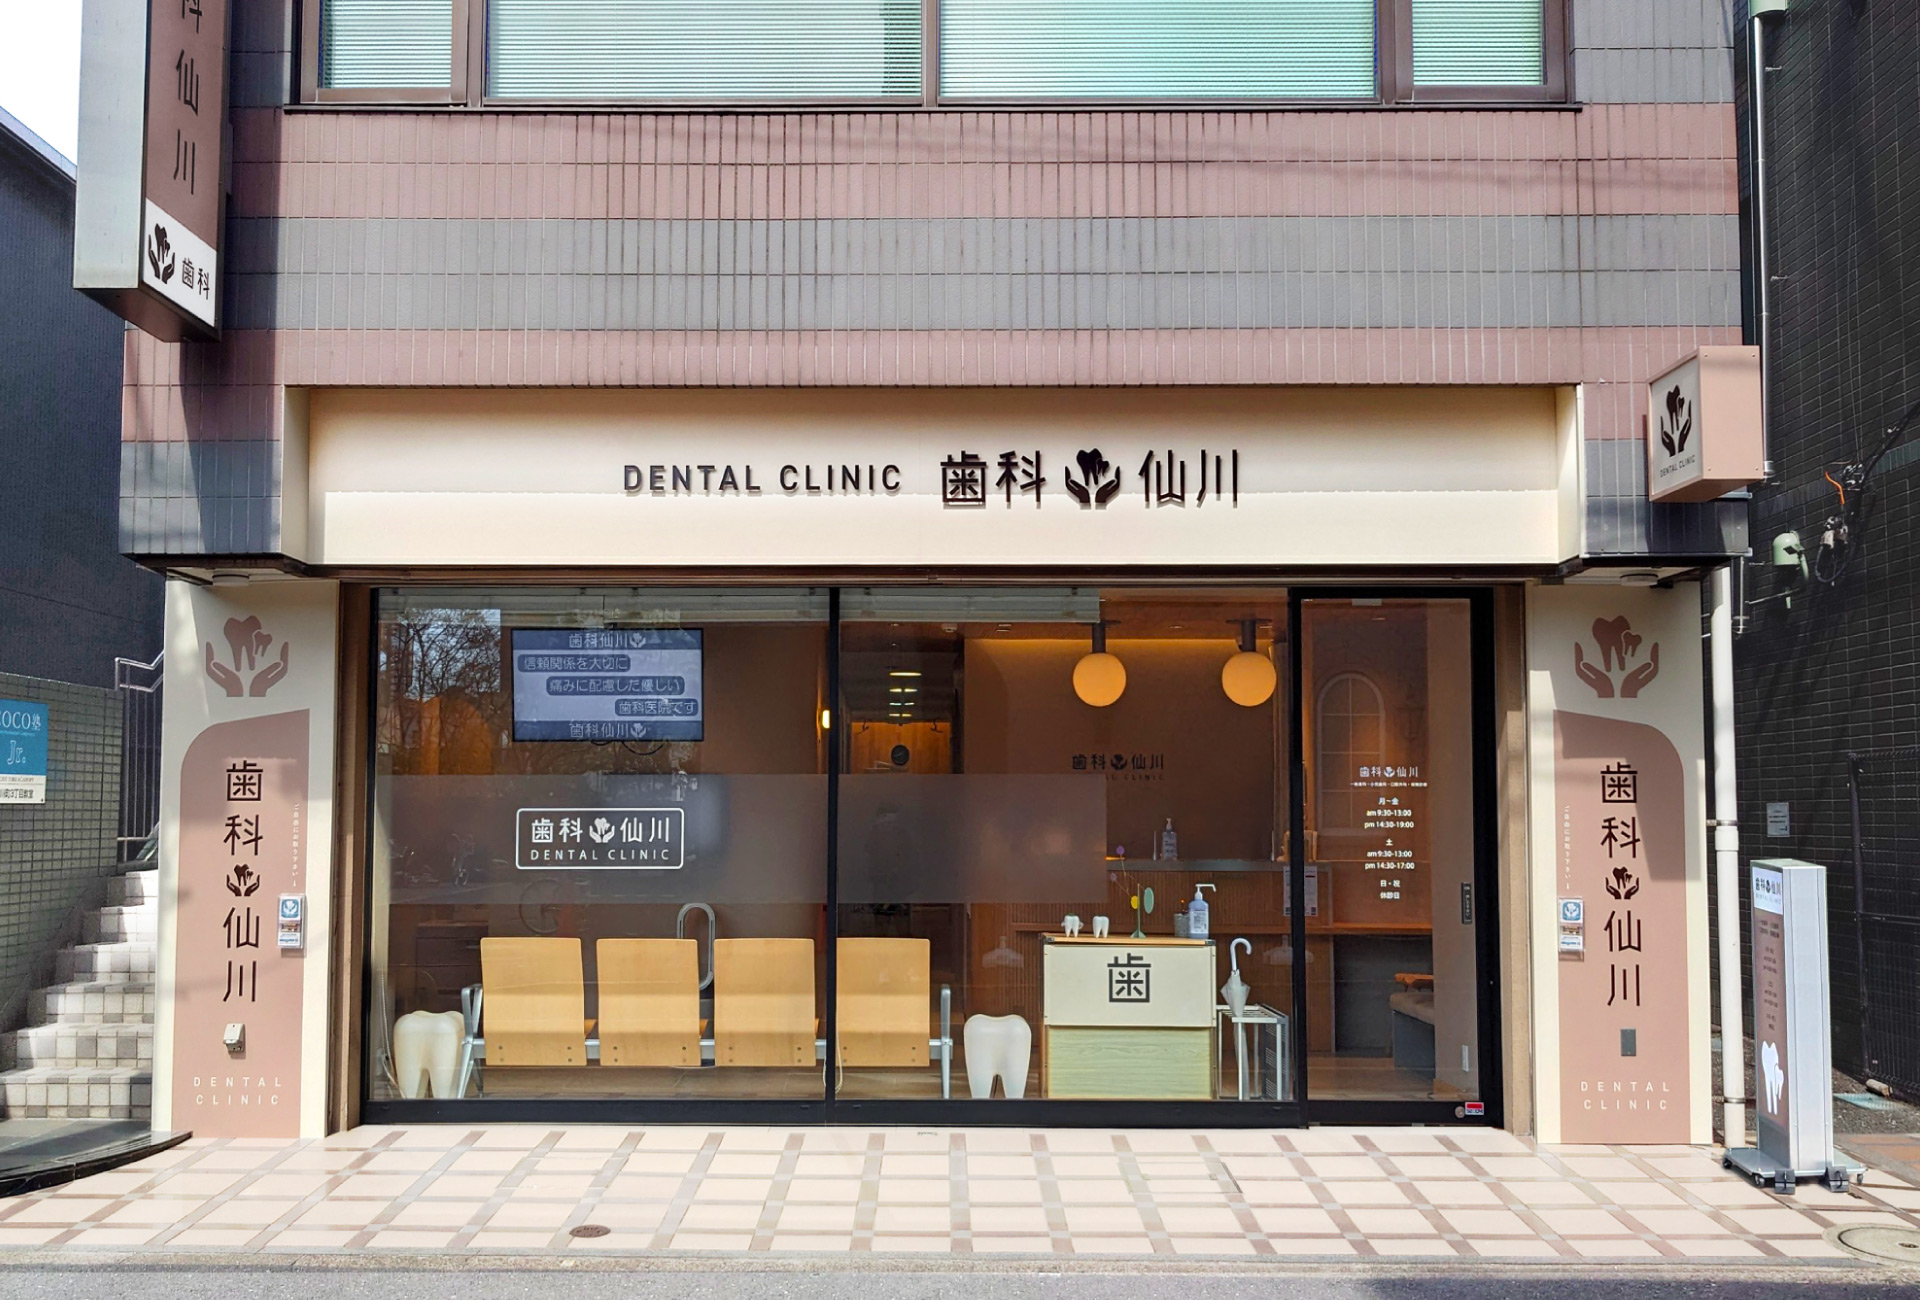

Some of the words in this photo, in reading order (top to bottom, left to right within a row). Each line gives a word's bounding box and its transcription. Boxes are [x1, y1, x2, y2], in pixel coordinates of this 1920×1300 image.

[181, 257, 210, 300] 歯科
[1660, 464, 1678, 477] DENTAL
[1679, 455, 1695, 468] CLINIC
[623, 464, 761, 492] DENTAL
[779, 464, 902, 492] CLINIC
[568, 632, 629, 648] 歯科仙川
[524, 655, 628, 671] 信頼関係を大切に
[549, 678, 680, 693] 痛みに配慮した優しい
[618, 700, 697, 715] 歯科医院です
[0, 710, 41, 731] OCO塾
[569, 723, 630, 738] 歯科仙川
[7, 740, 27, 765] Jr.
[1124, 773, 1165, 781] CLINIC
[1377, 809, 1412, 817] 9:30-13:00
[1364, 821, 1375, 830] pm
[1376, 821, 1415, 829] 14:30-19:00
[530, 849, 599, 861] DENTAL
[607, 849, 670, 861] CLINIC
[1377, 850, 1413, 858] 9:30-13:00
[1365, 862, 1376, 871] pm
[1376, 862, 1415, 870] 14:30-17:00
[1107, 953, 1151, 1003] 歯
[193, 1076, 281, 1088] DENTAL
[1580, 1081, 1670, 1093] DENTAL
[196, 1094, 279, 1106] CLINIC
[1583, 1099, 1668, 1111] CLINIC
